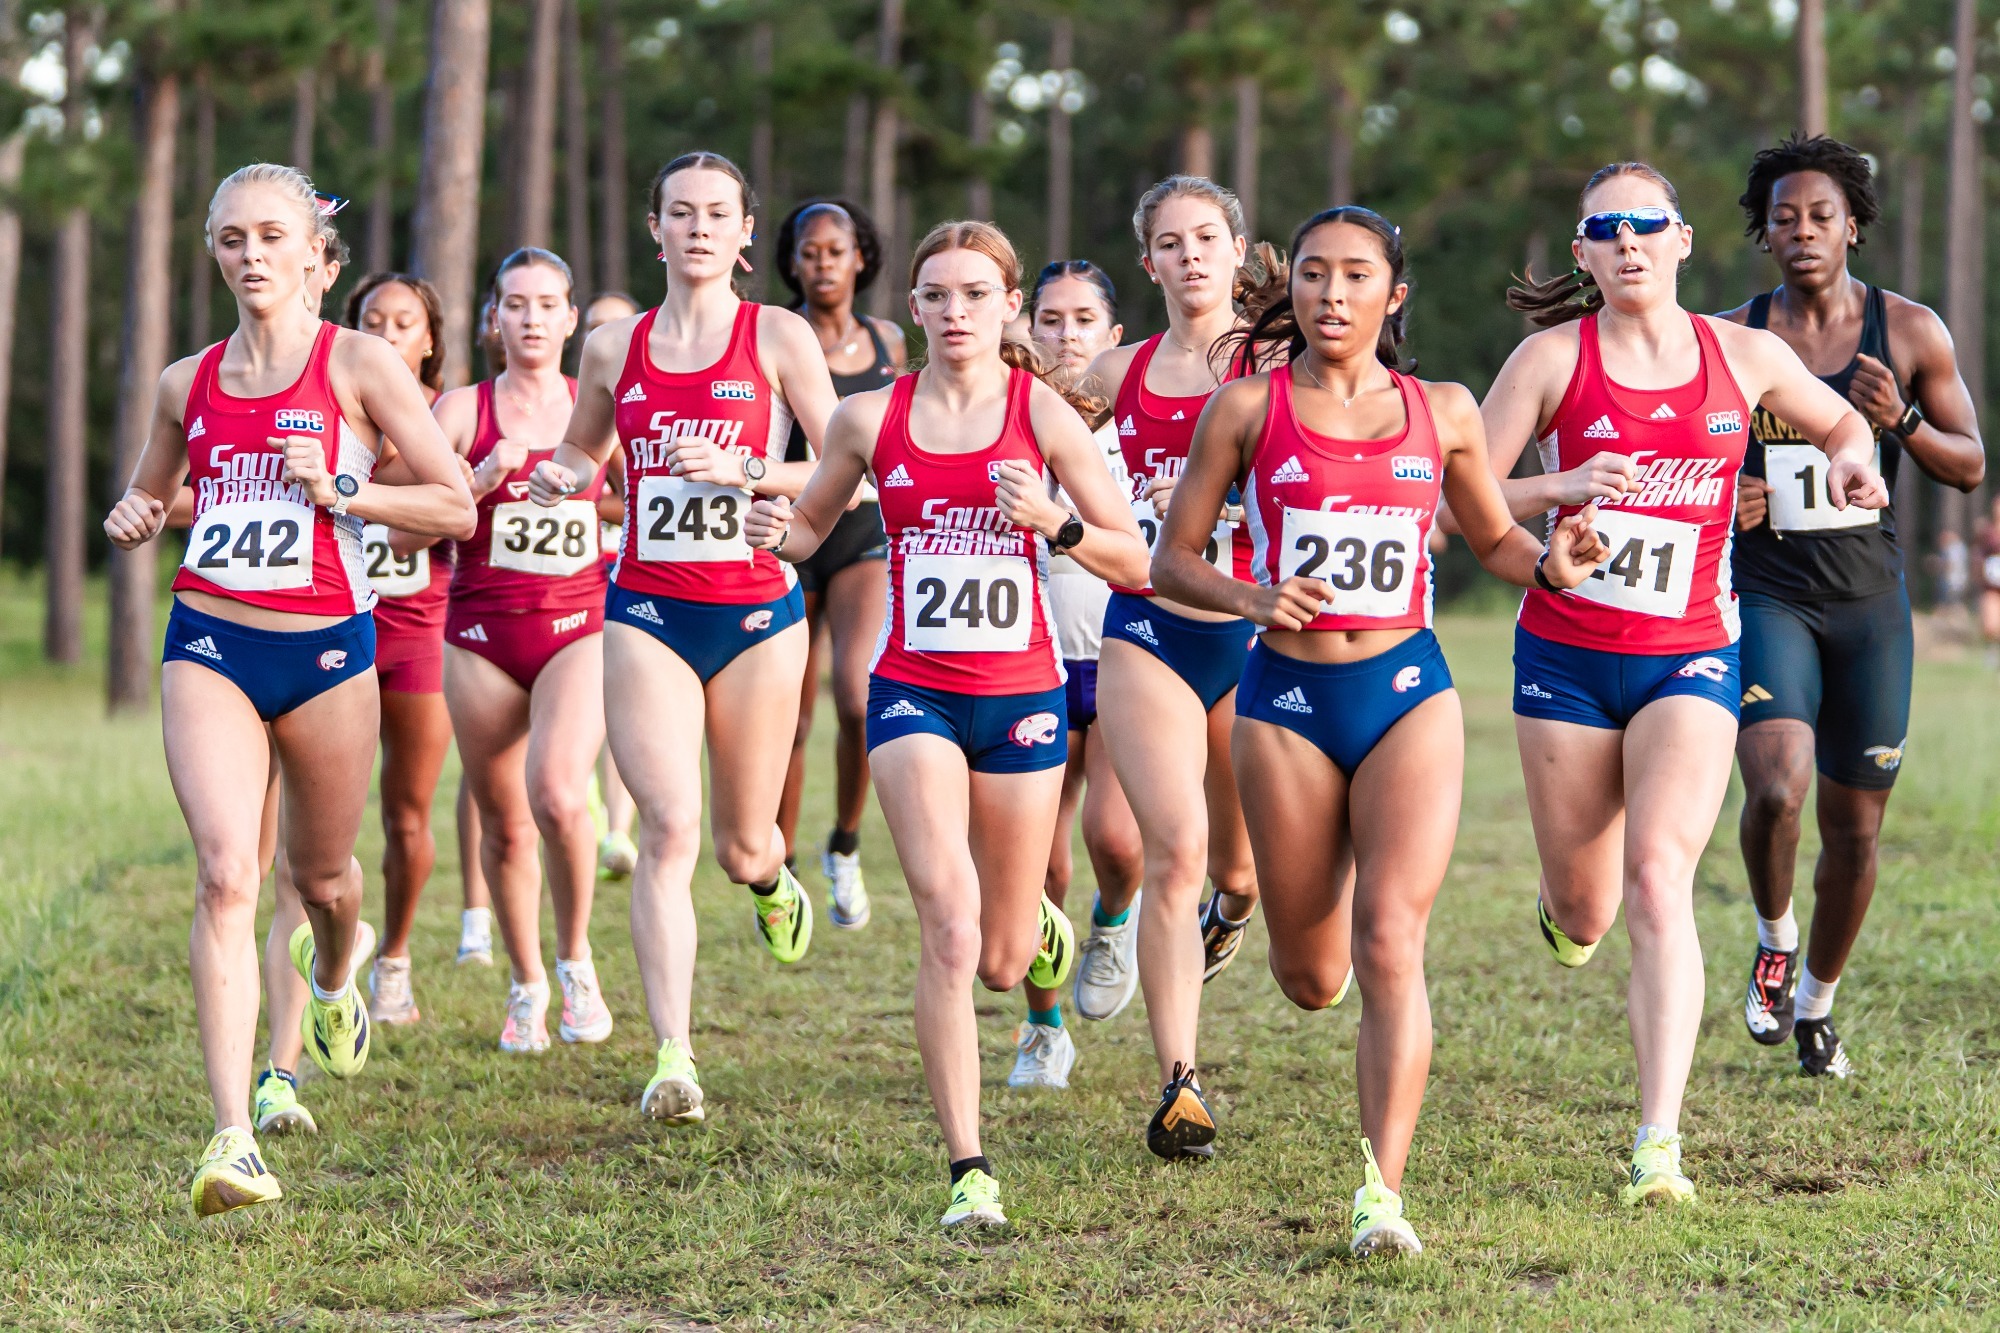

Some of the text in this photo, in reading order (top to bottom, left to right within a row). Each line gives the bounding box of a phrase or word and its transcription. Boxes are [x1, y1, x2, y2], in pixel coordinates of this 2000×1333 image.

[711, 380, 756, 400] SBC
[275, 409, 325, 433] SBC
[1706, 410, 1742, 434] SBC
[1752, 410, 1802, 440] BAM
[1583, 430, 1620, 439] adidas
[210, 444, 286, 484] SOUT
[1391, 455, 1434, 482] SBC
[884, 478, 914, 487] adidas
[1270, 472, 1310, 484] adidas
[648, 494, 739, 541] 243
[197, 518, 300, 569] 242
[504, 515, 587, 558] 328
[898, 526, 1025, 556] ALABAMA
[1294, 534, 1406, 593] 236
[916, 577, 1019, 629] 240
[552, 609, 588, 635] TROY
[626, 606, 664, 626] adidas
[1125, 623, 1159, 646] adidas
[184, 643, 223, 661] adidas
[880, 708, 925, 720] adidas
[1272, 698, 1313, 714] adidas
